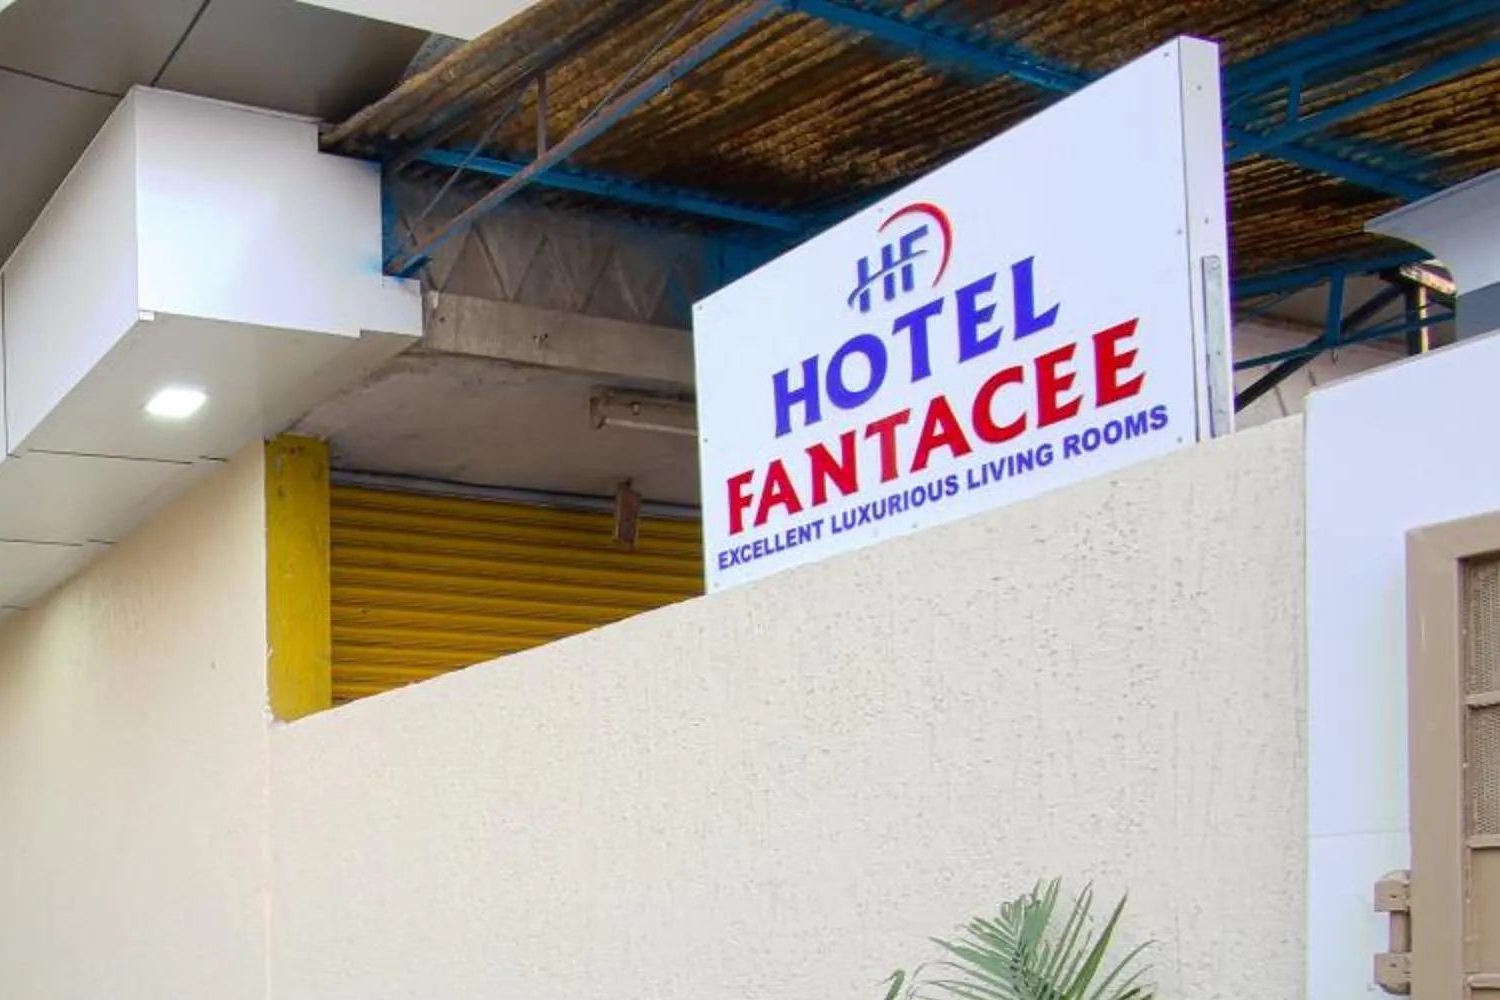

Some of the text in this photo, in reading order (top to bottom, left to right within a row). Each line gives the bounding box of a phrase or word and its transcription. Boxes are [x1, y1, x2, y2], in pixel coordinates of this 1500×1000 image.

[726, 317, 1146, 536] FANTACEE
[772, 255, 1060, 438] HOTEL
[717, 404, 1169, 571] EXCELLENT LUXURIOUS LIVING ROOMS
